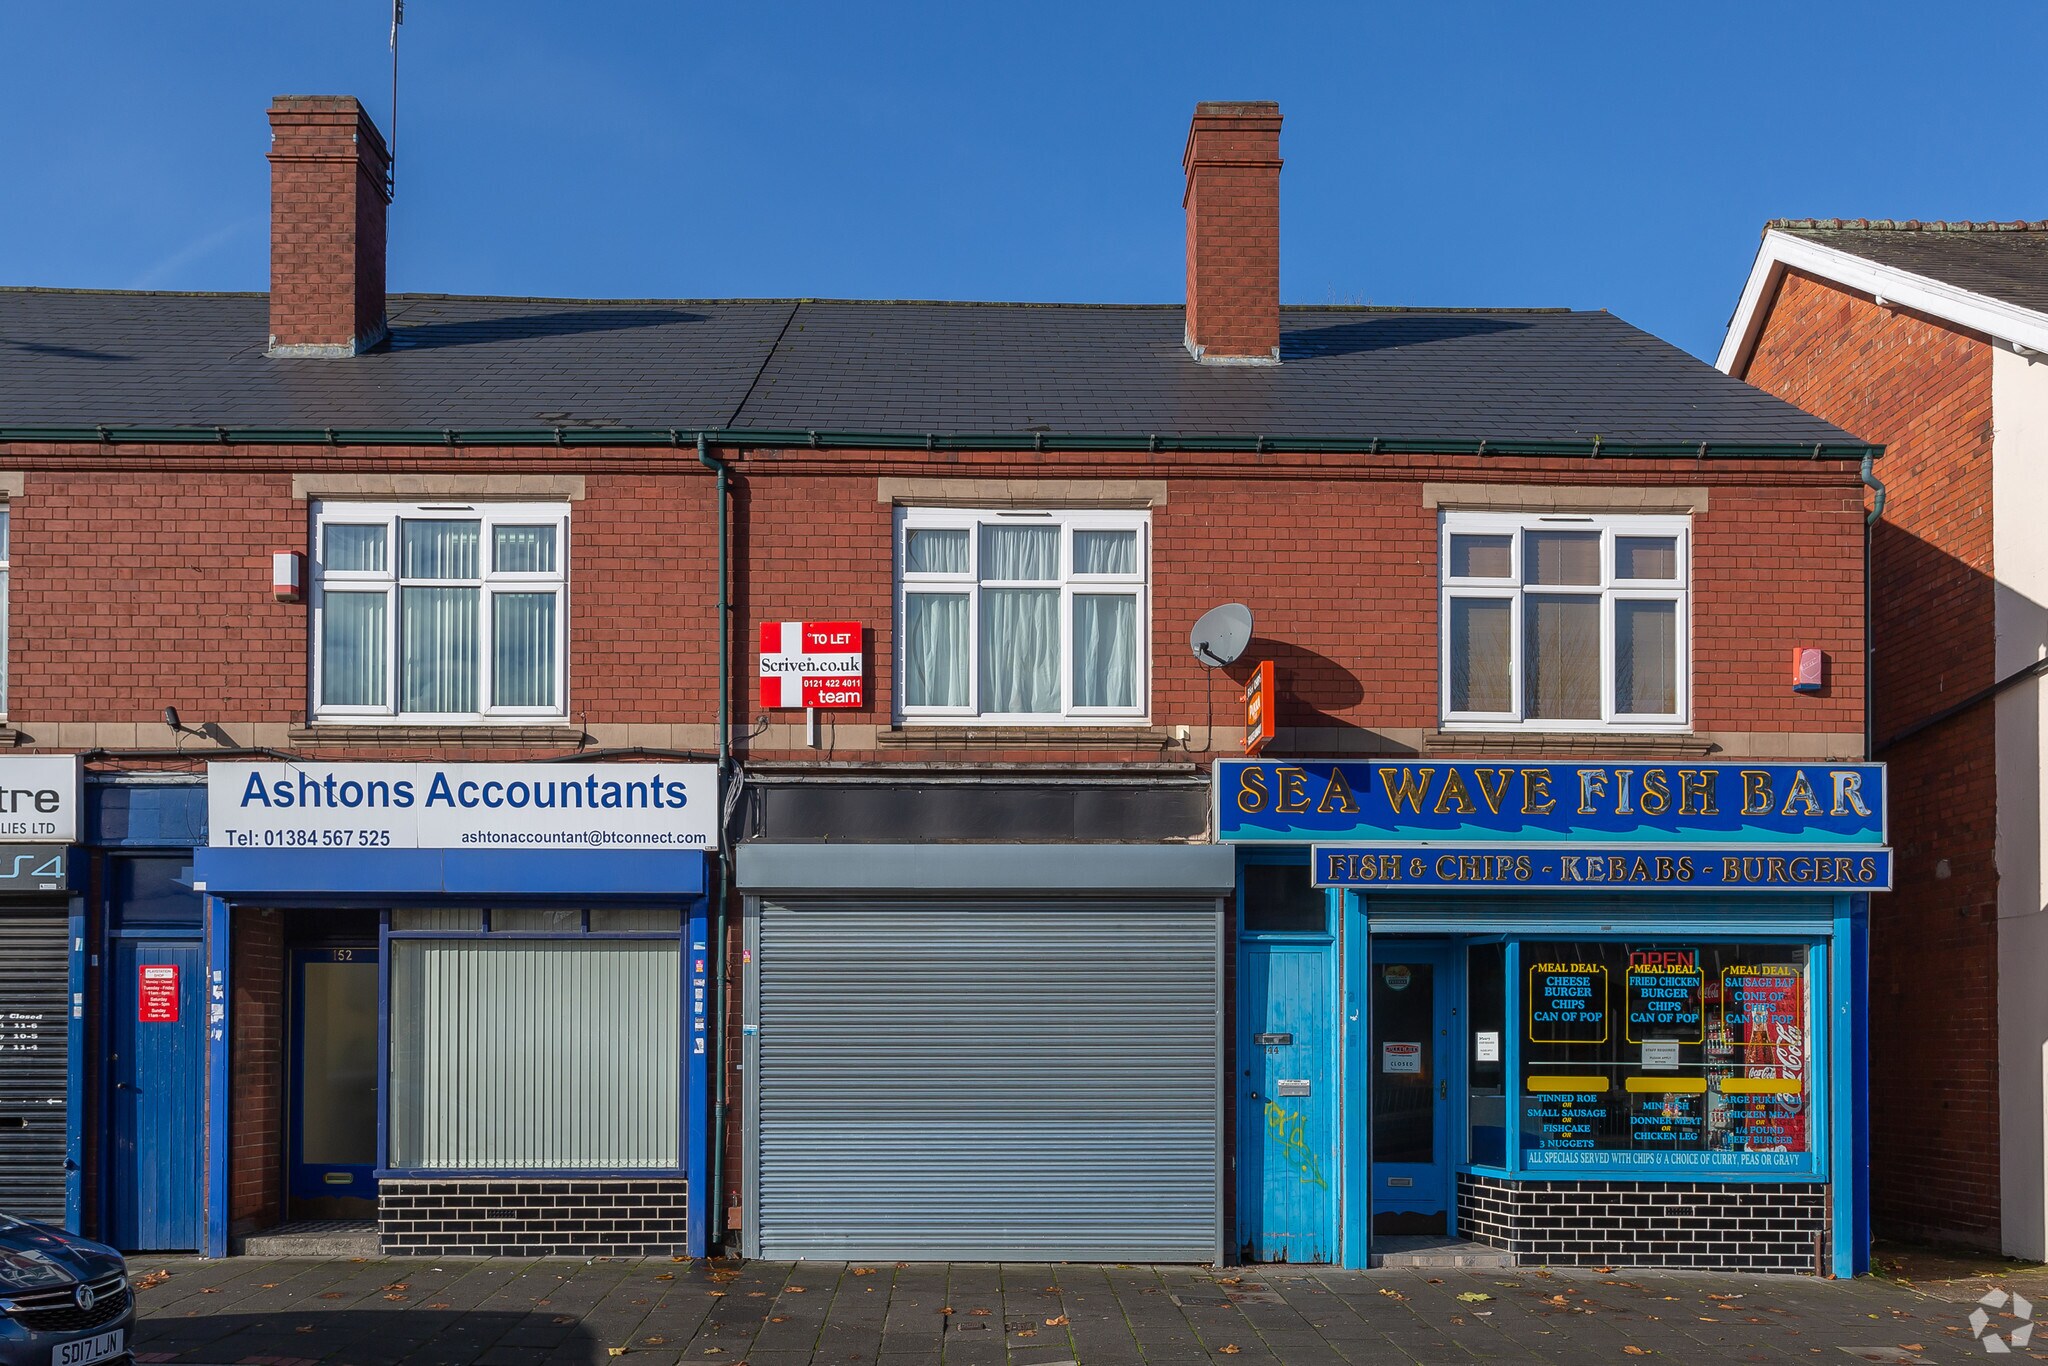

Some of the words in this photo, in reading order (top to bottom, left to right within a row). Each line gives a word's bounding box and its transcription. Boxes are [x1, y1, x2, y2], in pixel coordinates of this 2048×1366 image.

[812, 633, 828, 645] TO
[830, 633, 851, 645] LET
[761, 656, 860, 673] Scriven.co.uk
[803, 679, 823, 688] 0121
[825, 679, 840, 688] 422
[842, 679, 861, 688] 4011
[818, 689, 860, 703] team
[240, 771, 415, 808] Ashtons
[425, 771, 688, 809] Accountants
[1237, 766, 1361, 814] SEA
[1378, 767, 1557, 816] WAVE
[1576, 768, 1720, 816] FISH
[1740, 769, 1872, 817] BAR
[32, 822, 56, 834] LTD
[225, 830, 259, 846] Tel:
[264, 830, 318, 847] 01384
[322, 830, 354, 847] 567
[358, 830, 391, 847] 525
[461, 830, 707, 846] ashtonaccountant@btconnect.com
[1327, 854, 1403, 881] FISH
[1409, 857, 1428, 878] &
[1435, 855, 1534, 882] CHIPS
[1560, 856, 1696, 882] KEBABS
[1721, 857, 1878, 883] BURGERS
[333, 949, 353, 961] 152
[1630, 951, 1694, 971] OPEN
[1538, 963, 1568, 973] MEAL
[1570, 963, 1600, 973] DEAL
[1634, 964, 1665, 974] MEAL
[1667, 964, 1696, 974] DEAL
[1730, 965, 1760, 975] MEAL
[1762, 966, 1791, 976] DEAL
[1546, 976, 1591, 986] CHEESE
[1629, 976, 1657, 986] FRIED
[1659, 977, 1700, 987] CHICKEN
[1725, 977, 1773, 988] SAUSAGE
[1775, 978, 1795, 988] BAP
[1544, 987, 1592, 997] BURGER
[1641, 988, 1689, 998] BURGER
[1734, 991, 1767, 1001] CONE
[1769, 991, 1785, 1001] OF
[1551, 999, 1585, 1009] CHIPS
[1648, 1001, 1682, 1011] CHIPS
[1743, 1003, 1777, 1013] CHIPS
[1534, 1012, 1559, 1021] CAN
[1561, 1012, 1578, 1021] OF
[1579, 1012, 1603, 1022] POP
[1630, 1013, 1655, 1022] CAN
[1657, 1013, 1674, 1023] OF
[1675, 1013, 1699, 1023] POP
[1725, 1014, 1750, 1024] CAN
[1753, 1014, 1769, 1024] OF
[1771, 1014, 1794, 1024] POP
[1537, 1094, 1574, 1103] TINNED
[1576, 1094, 1598, 1103] ROE
[1718, 1095, 1750, 1104] LARGE
[1527, 1109, 1560, 1117] SMALL
[1561, 1109, 1607, 1118] SAUSAGE
[1725, 1111, 1766, 1119] CHICKEN
[1768, 1111, 1796, 1119] MEAT
[1630, 1116, 1672, 1125] DONNER
[1674, 1117, 1702, 1125] MEAT
[1543, 1124, 1591, 1133] FISHCAKE
[1735, 1126, 1747, 1135] 1/4
[1749, 1126, 1784, 1135] POUND
[1634, 1132, 1676, 1140] CHICKEN
[1679, 1132, 1698, 1140] LEG
[1727, 1135, 1751, 1144] BEEF
[1753, 1136, 1793, 1144] BURGER
[1539, 1140, 1545, 1148] 3
[1548, 1139, 1595, 1148] NUGGETS
[1529, 1152, 1543, 1163] ALL
[1544, 1152, 1578, 1164] SPECIALS
[1580, 1152, 1609, 1164] SERVED
[1611, 1152, 1631, 1164] WITH
[1632, 1153, 1655, 1164] CHIPS
[1656, 1153, 1662, 1164] &
[1664, 1153, 1670, 1164] A
[1671, 1153, 1699, 1165] CHOICE
[1700, 1153, 1710, 1165] OF
[1712, 1153, 1740, 1167] CURRY,
[1741, 1154, 1760, 1165] PEAS
[1761, 1154, 1772, 1165] OR
[1774, 1154, 1799, 1165] GRAVY
[61, 1339, 93, 1365] SD17
[95, 1332, 117, 1356] LJN
